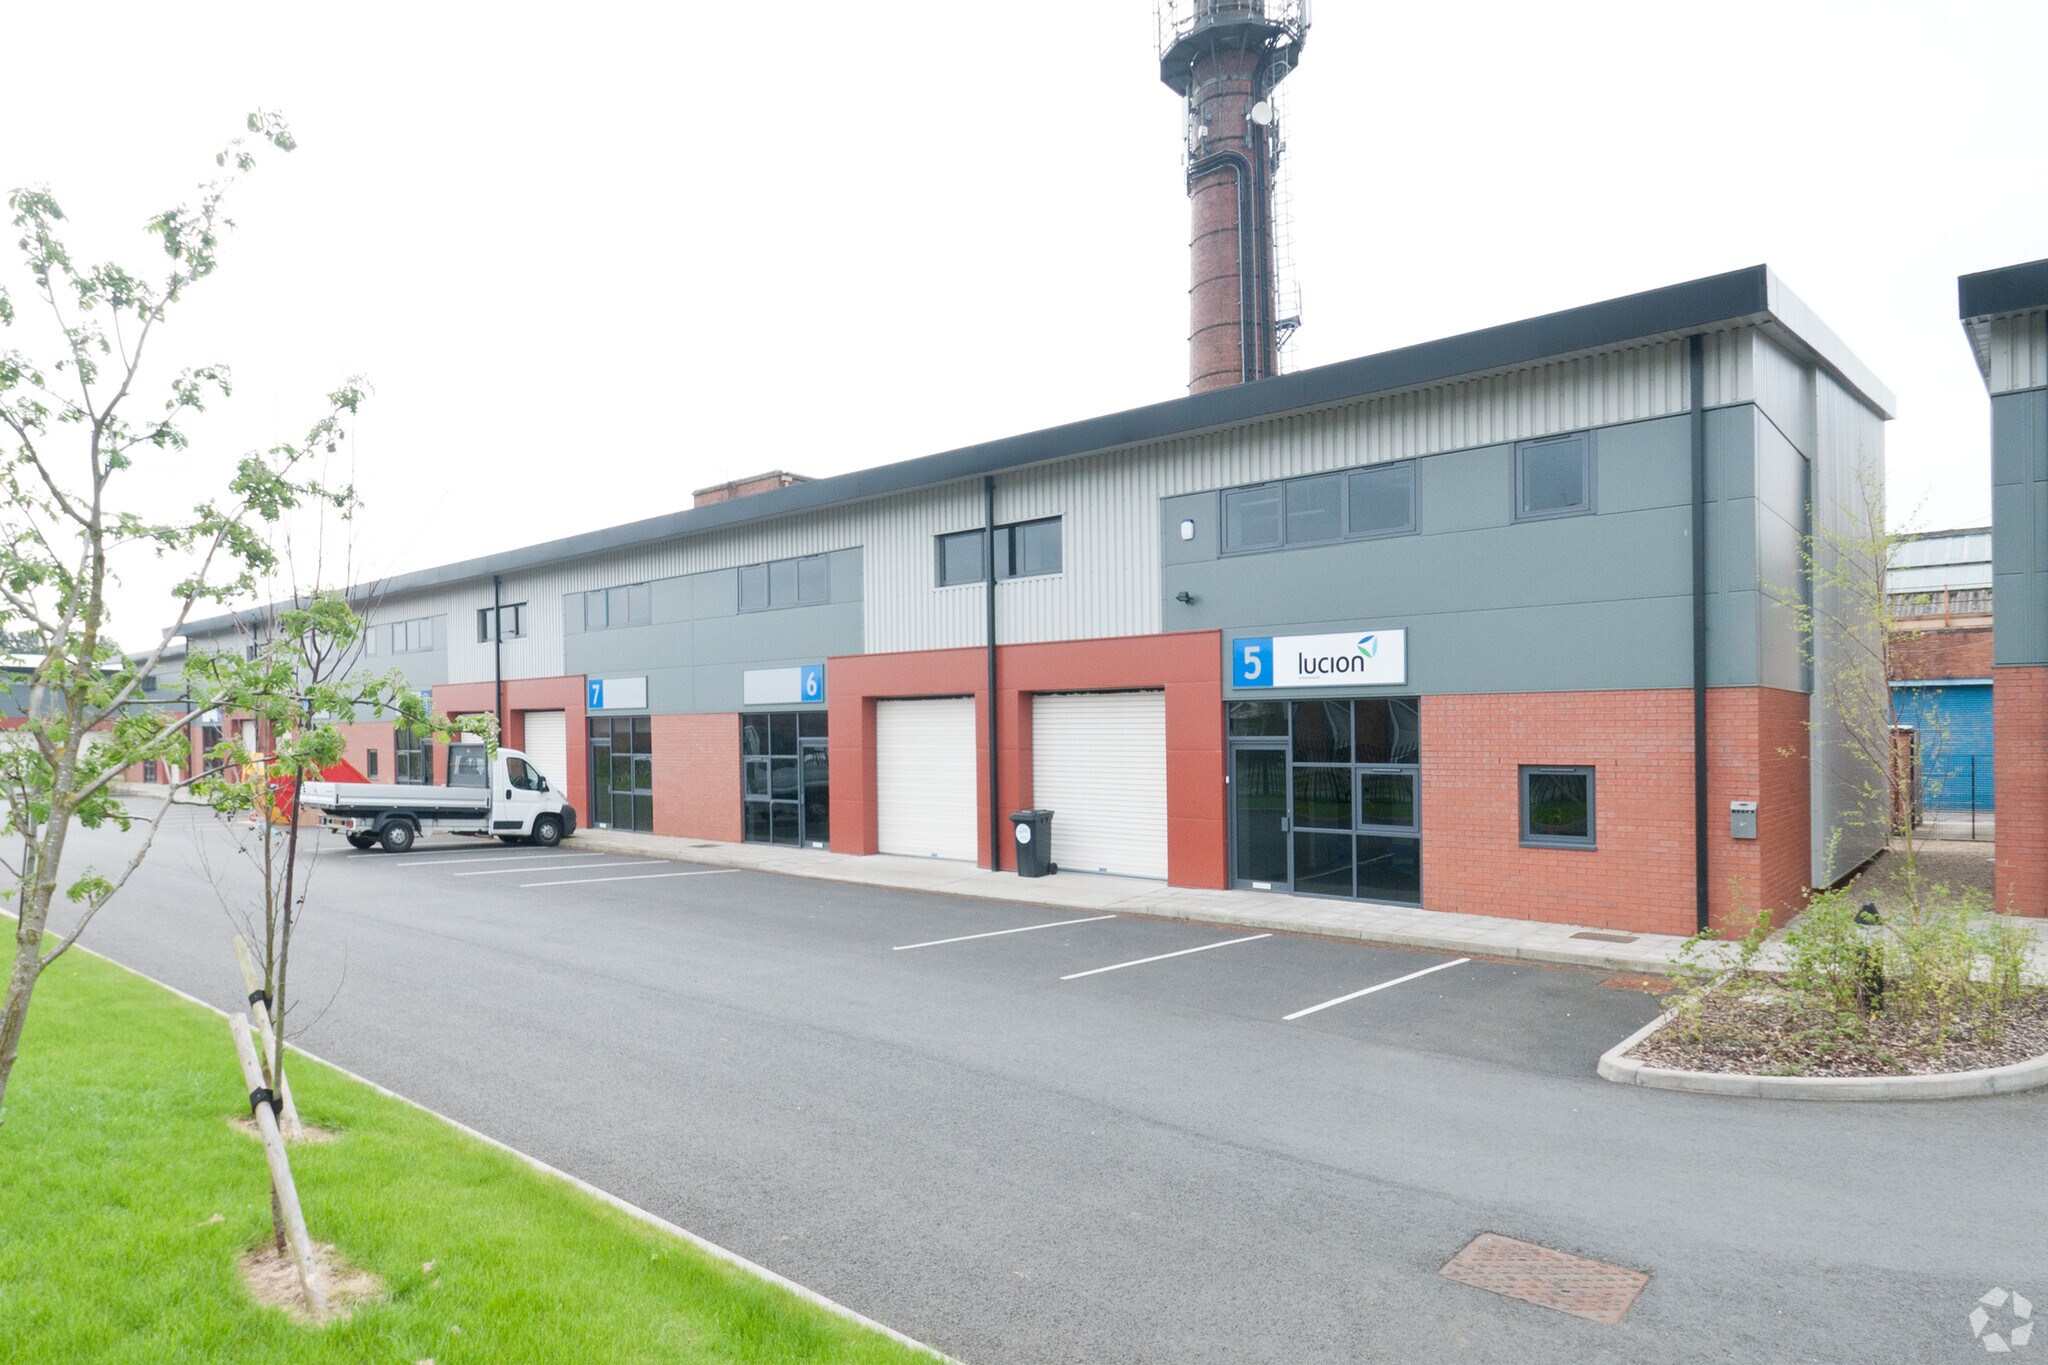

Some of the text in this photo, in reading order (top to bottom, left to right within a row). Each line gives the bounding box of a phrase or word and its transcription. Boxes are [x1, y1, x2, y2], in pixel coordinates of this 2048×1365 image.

[1244, 646, 1365, 680] 5 lucion
[592, 684, 600, 705] 7
[806, 671, 818, 696] 6
